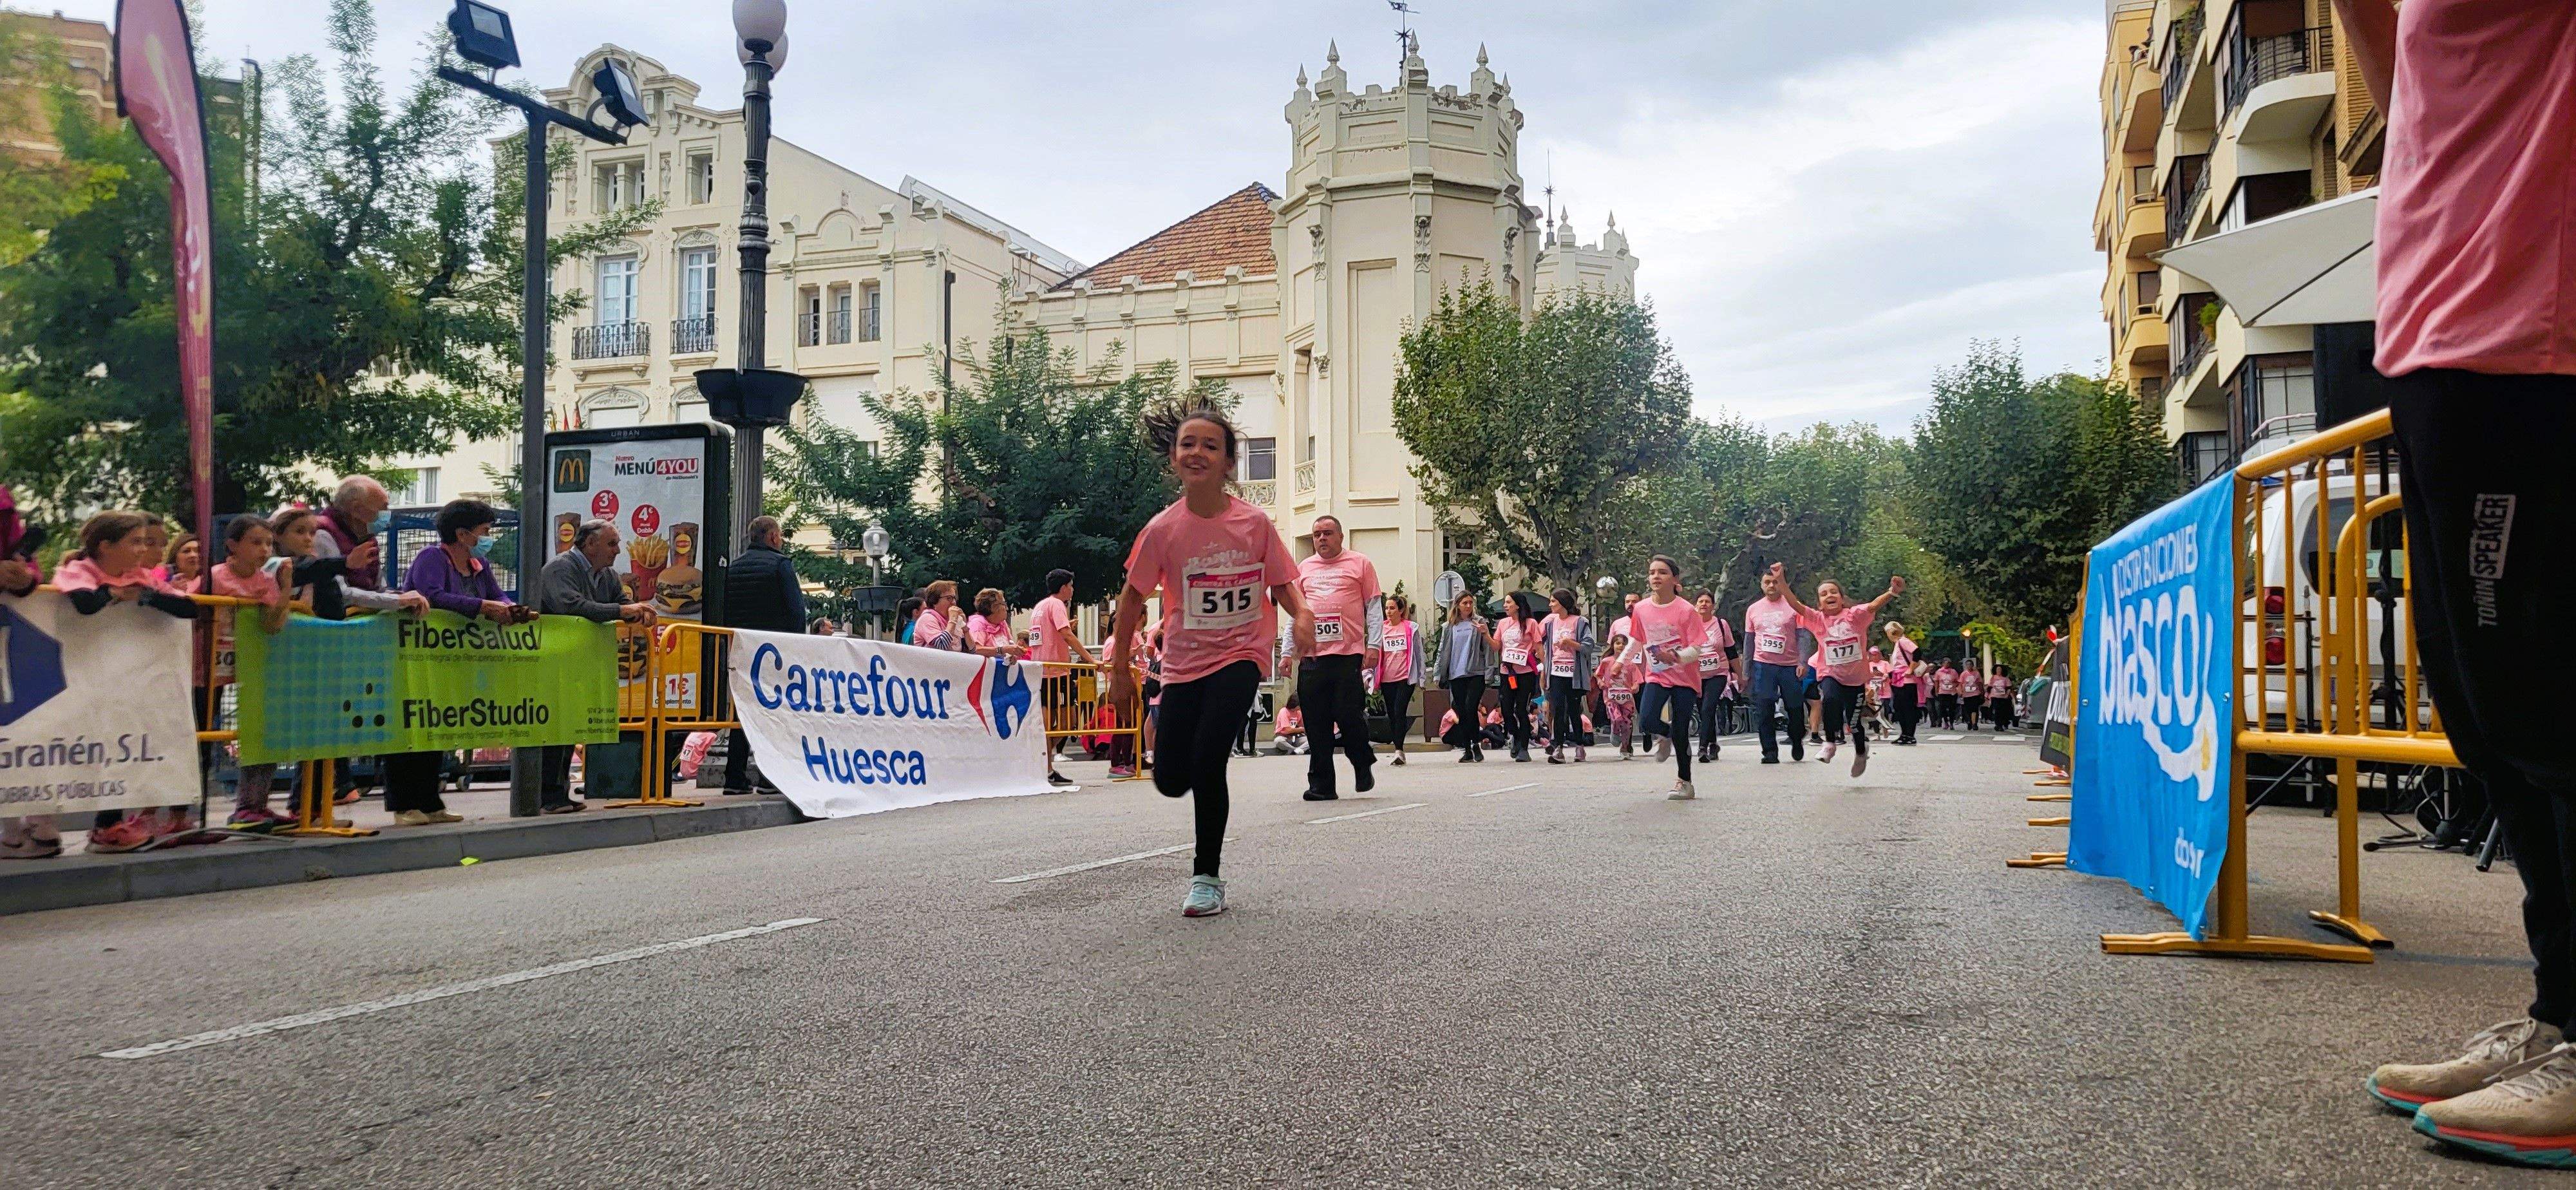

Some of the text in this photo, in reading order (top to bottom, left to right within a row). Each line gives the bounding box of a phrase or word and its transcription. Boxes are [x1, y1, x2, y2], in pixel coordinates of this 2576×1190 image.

[611, 429, 640, 437] URBAN
[614, 457, 699, 476] MENÚ 4YOU
[2474, 497, 2510, 576] SPEAKER
[1202, 587, 1251, 614] 515
[398, 618, 540, 650] FiberSalud
[1314, 623, 1340, 636] 505
[1387, 638, 1405, 647] 1852
[1763, 639, 1783, 649] 2955
[1832, 645, 1854, 658] 177
[750, 643, 951, 720] Carrefour
[402, 697, 549, 729] FiberStudio
[117, 733, 164, 763] S.L.
[802, 735, 927, 786] Huesca
